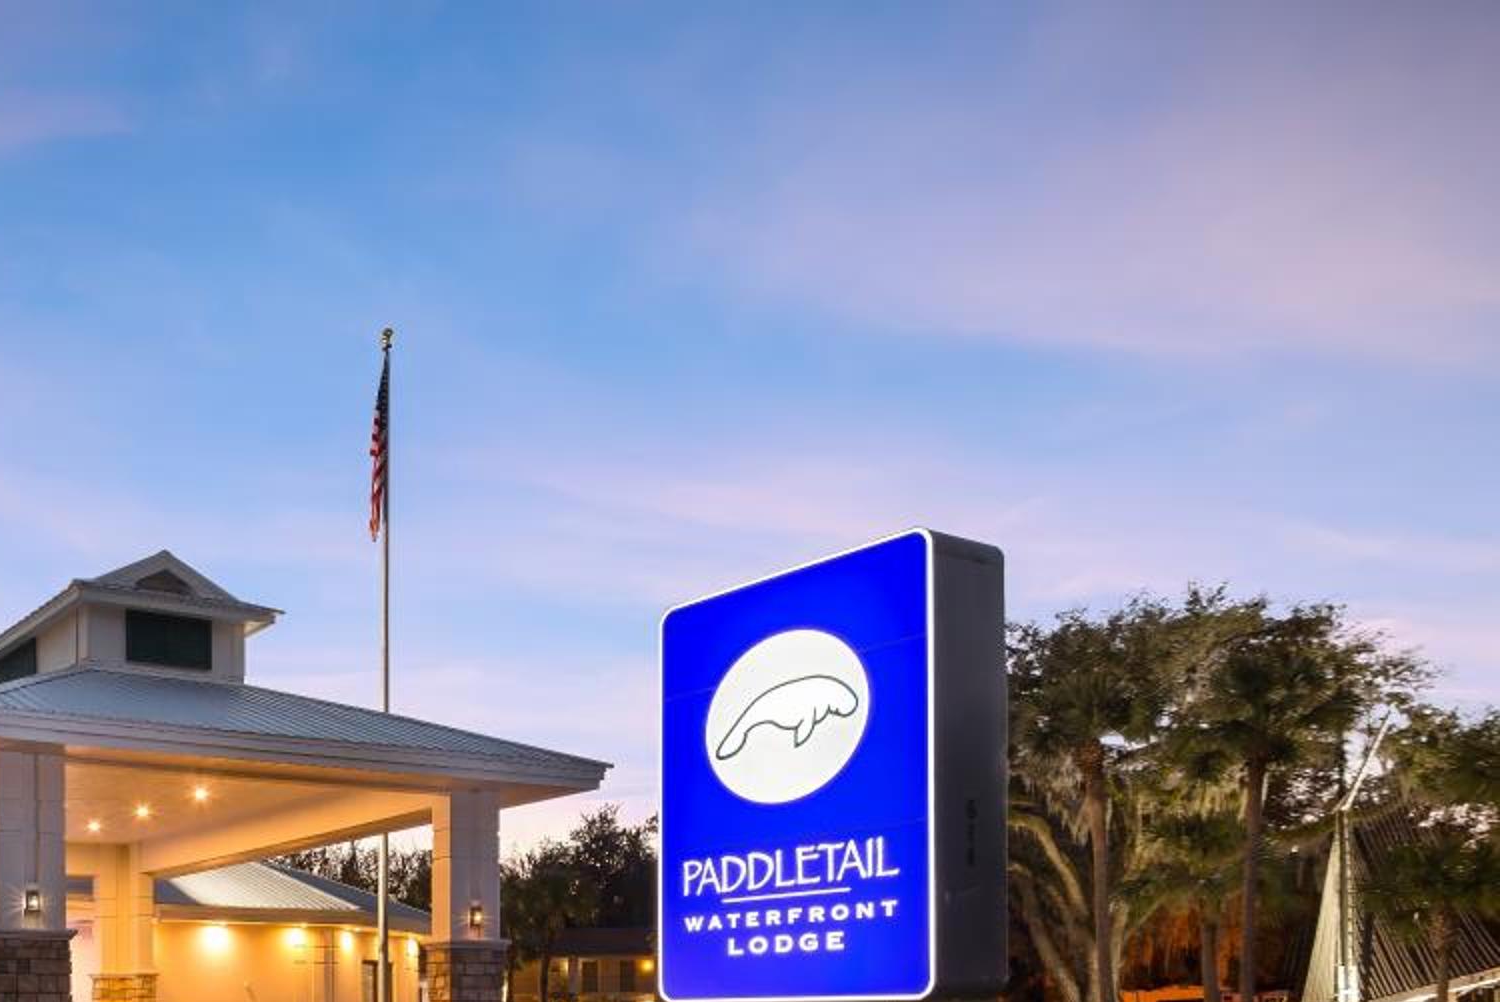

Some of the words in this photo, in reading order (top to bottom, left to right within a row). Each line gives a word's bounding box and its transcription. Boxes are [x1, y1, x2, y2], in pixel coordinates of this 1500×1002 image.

[682, 835, 900, 897] PADDLETAIL
[684, 899, 898, 933] WATERFRONT
[727, 931, 845, 956] LODGE
